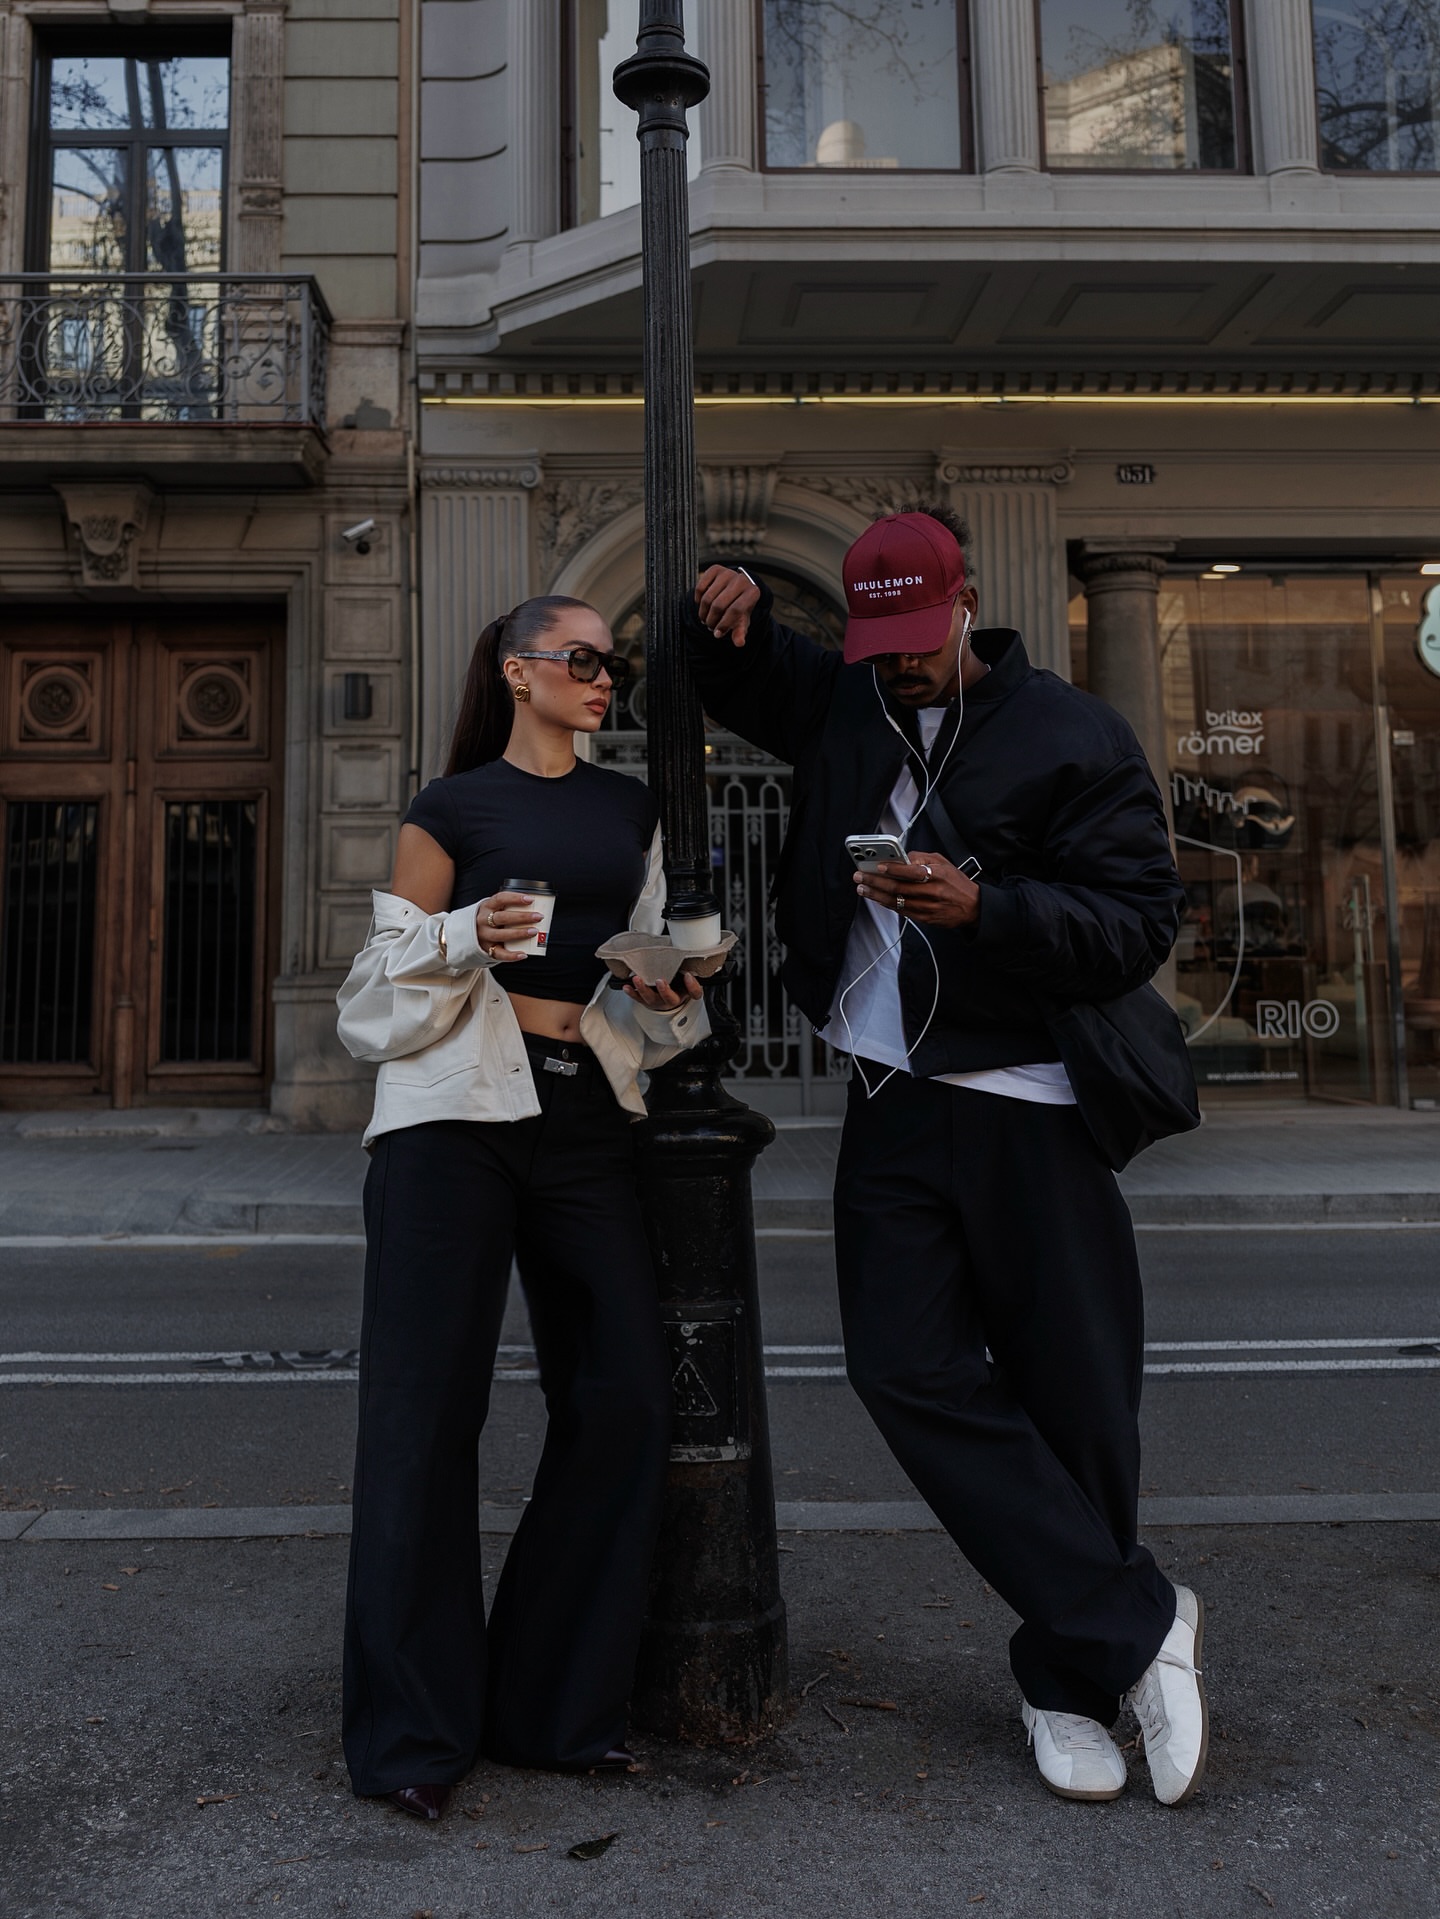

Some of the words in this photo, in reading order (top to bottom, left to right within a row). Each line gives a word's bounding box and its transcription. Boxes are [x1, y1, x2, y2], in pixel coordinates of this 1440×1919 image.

[853, 575, 924, 593] LULULEMON
[868, 592, 884, 600] EST.
[884, 589, 902, 599] 1998
[1205, 709, 1264, 726] britax
[1177, 730, 1265, 755] römer
[1256, 999, 1340, 1039] RIO
